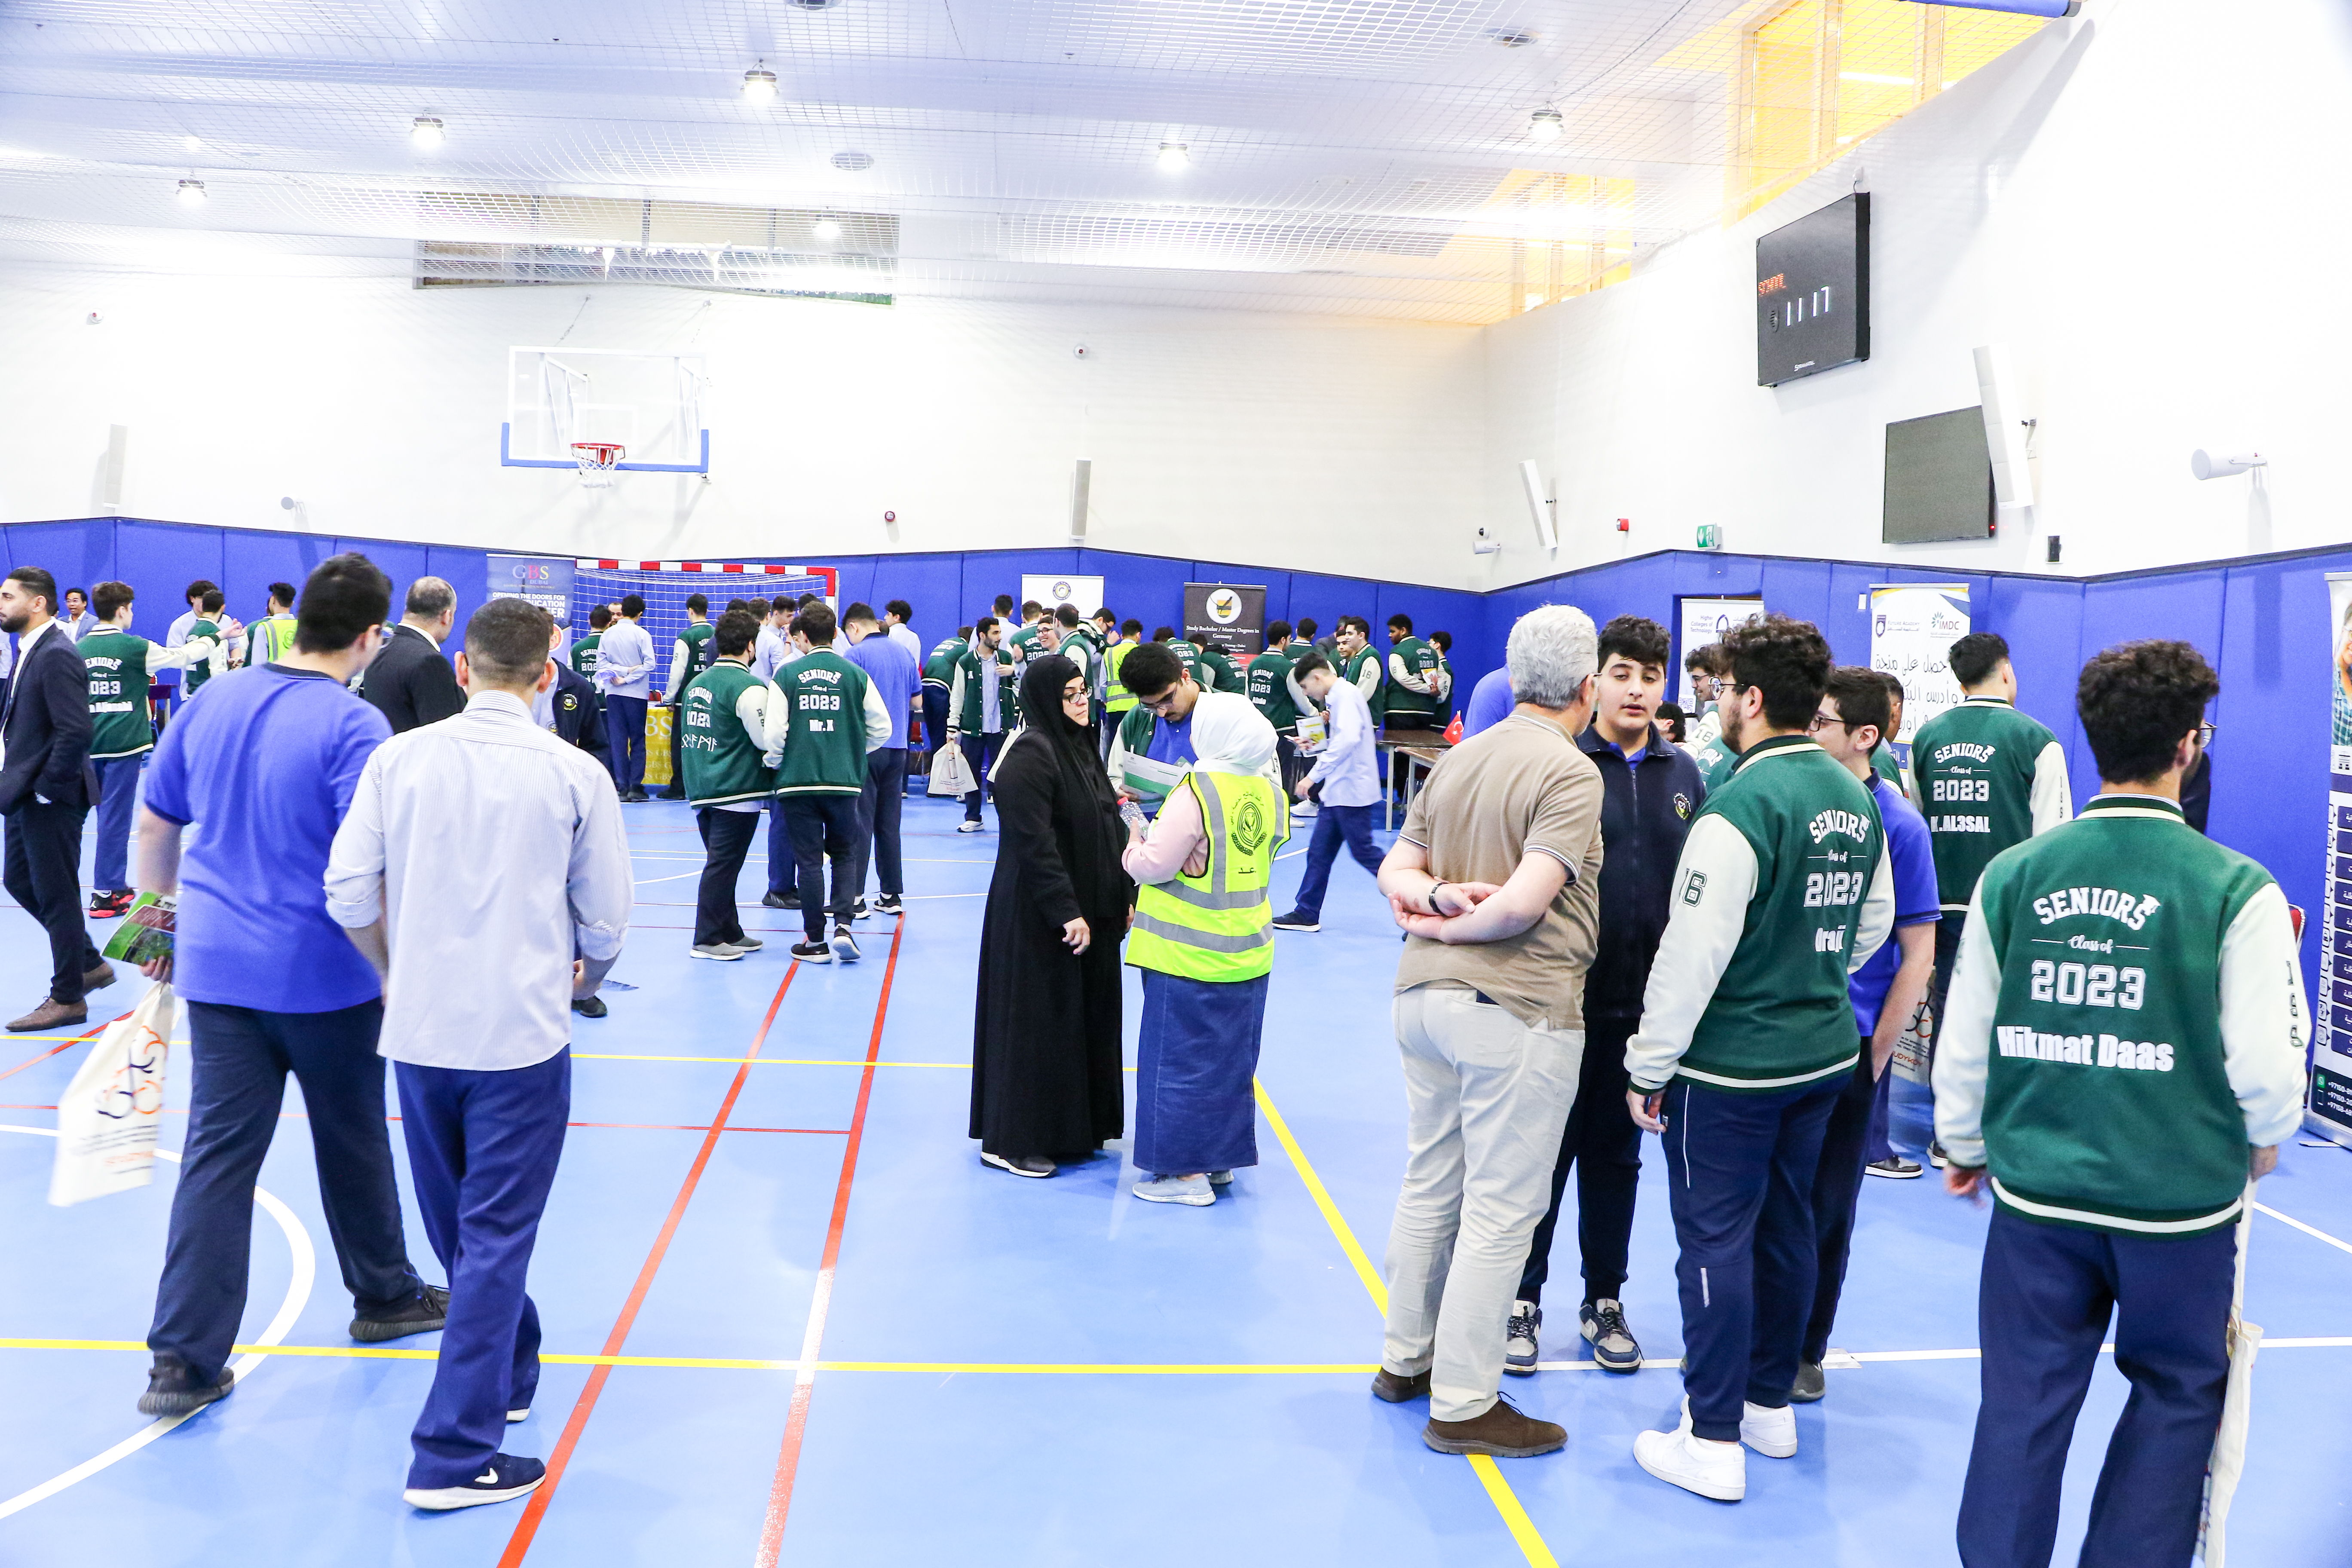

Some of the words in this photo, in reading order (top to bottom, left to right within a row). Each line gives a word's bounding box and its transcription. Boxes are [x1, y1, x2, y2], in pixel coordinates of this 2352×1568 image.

[512, 565, 549, 580] GBS
[1939, 621, 1960, 630] IMDC
[1024, 637, 1041, 646] SENI
[580, 649, 597, 657] SENIO
[84, 657, 123, 671] ENIORS
[581, 662, 598, 671] 202
[798, 669, 841, 684] SENIORS
[1252, 669, 1274, 679] SENIORS
[89, 680, 121, 695] 023
[688, 686, 713, 704] SENIORS
[1251, 683, 1271, 694] 2023
[799, 694, 840, 710] 2023
[645, 715, 672, 737] BS
[809, 719, 834, 732] Mr.X
[1696, 729, 1713, 742] 16
[1934, 742, 1995, 764] SENIORS
[1950, 766, 1966, 774] Class
[1933, 779, 1990, 802] 2023
[1809, 809, 1870, 844] SENIORS
[1930, 815, 1991, 833] K.AL3SAL
[1839, 851, 1848, 863] of
[1804, 871, 1864, 907] 2023
[2033, 886, 2156, 931] SENIORS
[2067, 934, 2099, 952] Class
[2099, 938, 2114, 954] of
[2031, 959, 2147, 1011] 2023
[1997, 1025, 2095, 1066] Hikmat
[2097, 1033, 2175, 1072] Daas
